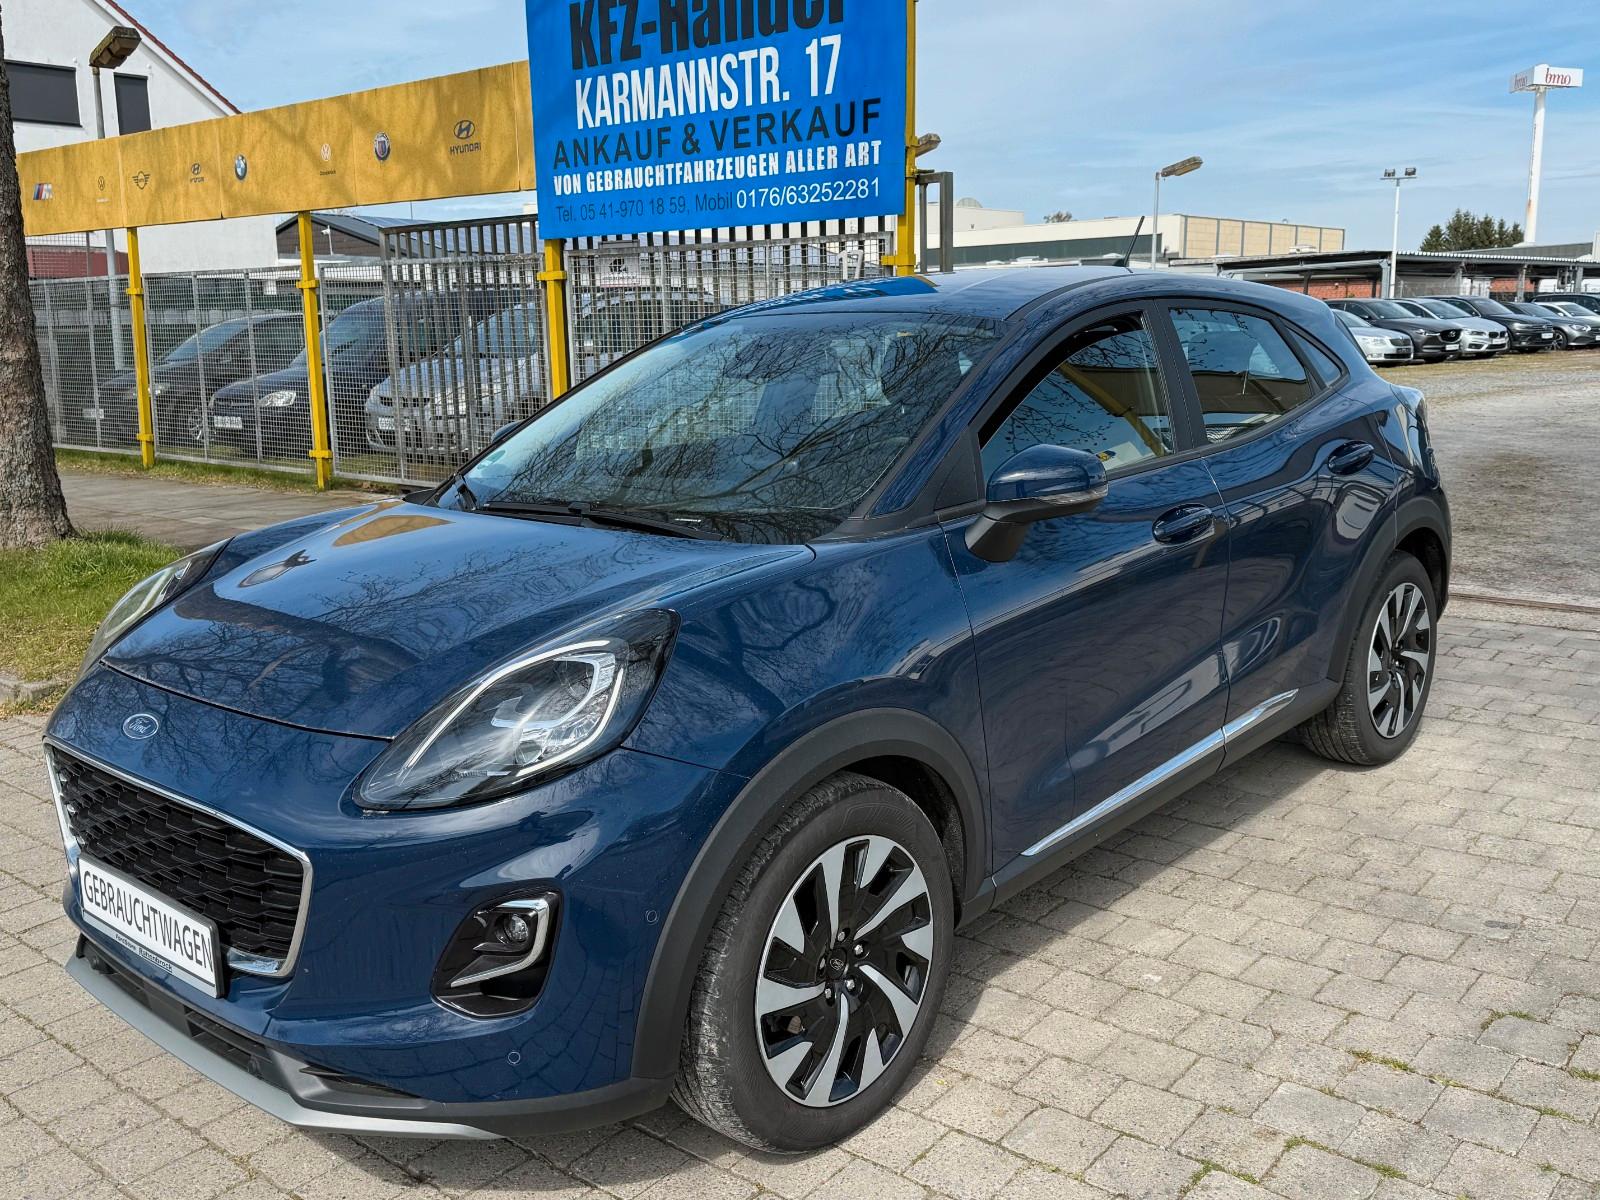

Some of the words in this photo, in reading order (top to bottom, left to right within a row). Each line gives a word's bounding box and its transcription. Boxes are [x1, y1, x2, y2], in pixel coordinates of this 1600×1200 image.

[569, 0, 843, 69] KFZ-Han
[575, 46, 790, 129] KARMANNSTR.
[806, 34, 842, 97] 17
[449, 142, 482, 157] HYUNDAI
[553, 126, 672, 169] ANKAUF
[681, 122, 701, 155] &
[709, 97, 882, 150] VERKAUF
[553, 173, 582, 195] VON
[586, 152, 779, 193] GEBRAUCHTFAHRZEUGEN
[785, 145, 838, 173] ALLER
[844, 140, 882, 168] ART
[556, 206, 577, 223] Tel.
[580, 203, 596, 221] 05
[599, 199, 644, 219] 41-970
[650, 197, 665, 215] 18
[669, 195, 690, 215] 59,
[695, 192, 733, 212] Mobil
[736, 177, 880, 208] 0176/63252281
[836, 249, 864, 280] 17
[83, 870, 214, 974] GEBRAUCHTWAGEN
